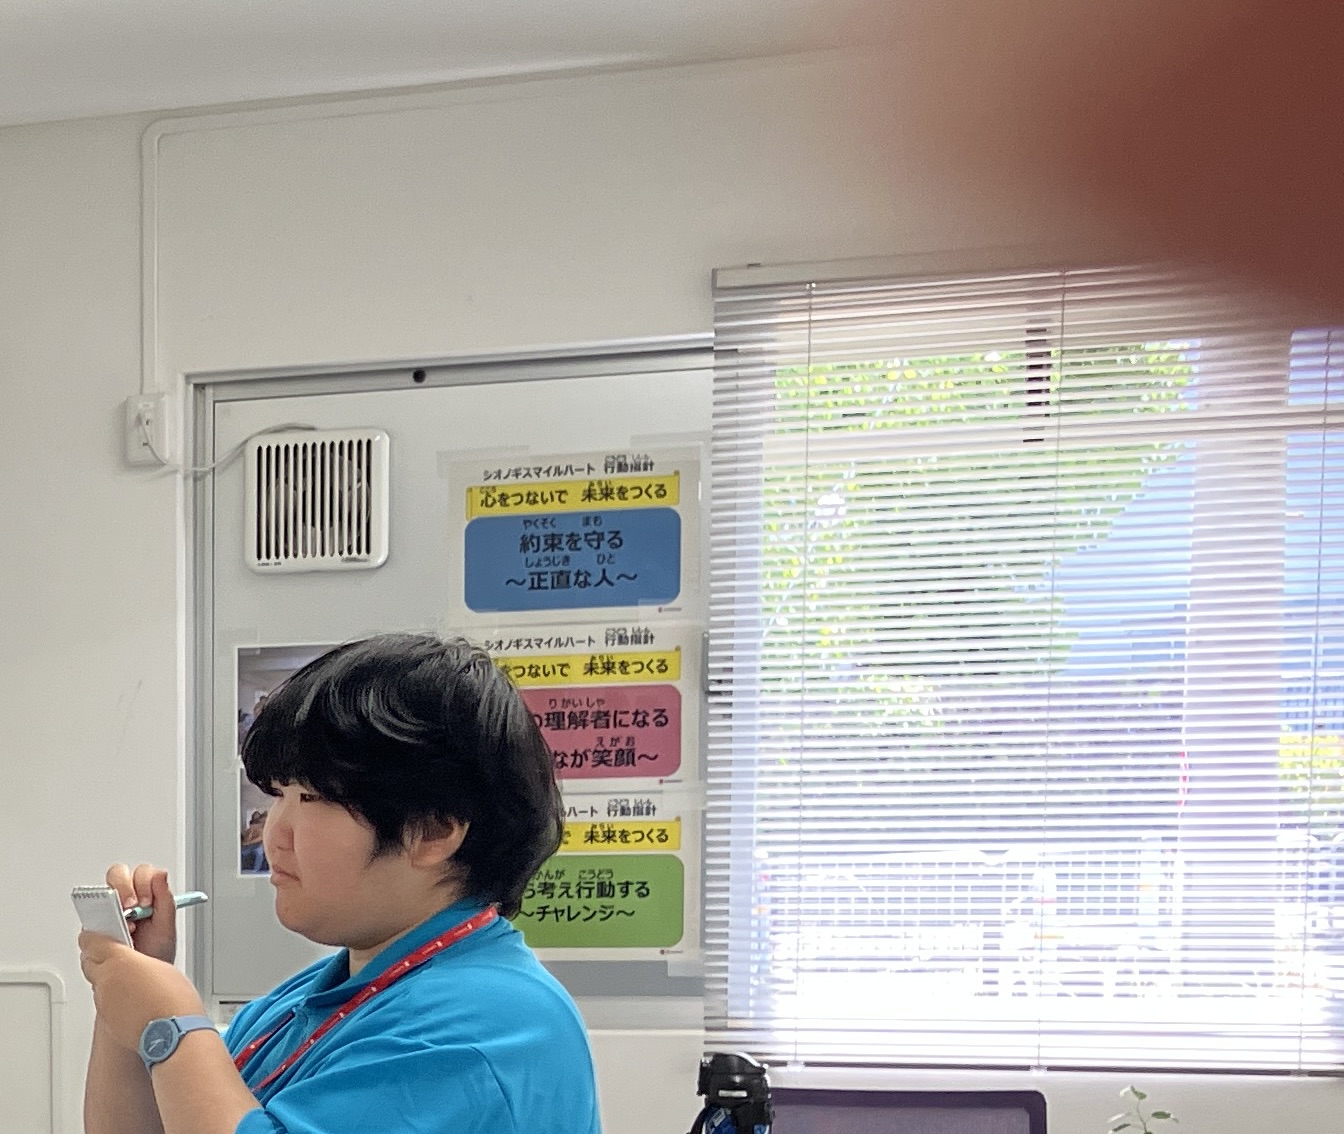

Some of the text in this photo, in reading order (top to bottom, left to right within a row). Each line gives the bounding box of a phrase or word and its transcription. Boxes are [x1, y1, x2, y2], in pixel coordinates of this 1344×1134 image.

[483, 463, 595, 481] シオノギスマイルハート
[480, 484, 667, 507] 心をつないで 未来をつくる
[519, 531, 624, 553] 約束を守る
[485, 636, 596, 650] シオノギスマイルハート
[583, 659, 668, 676] 未来をつくる
[584, 830, 668, 844] 未来をつくる
